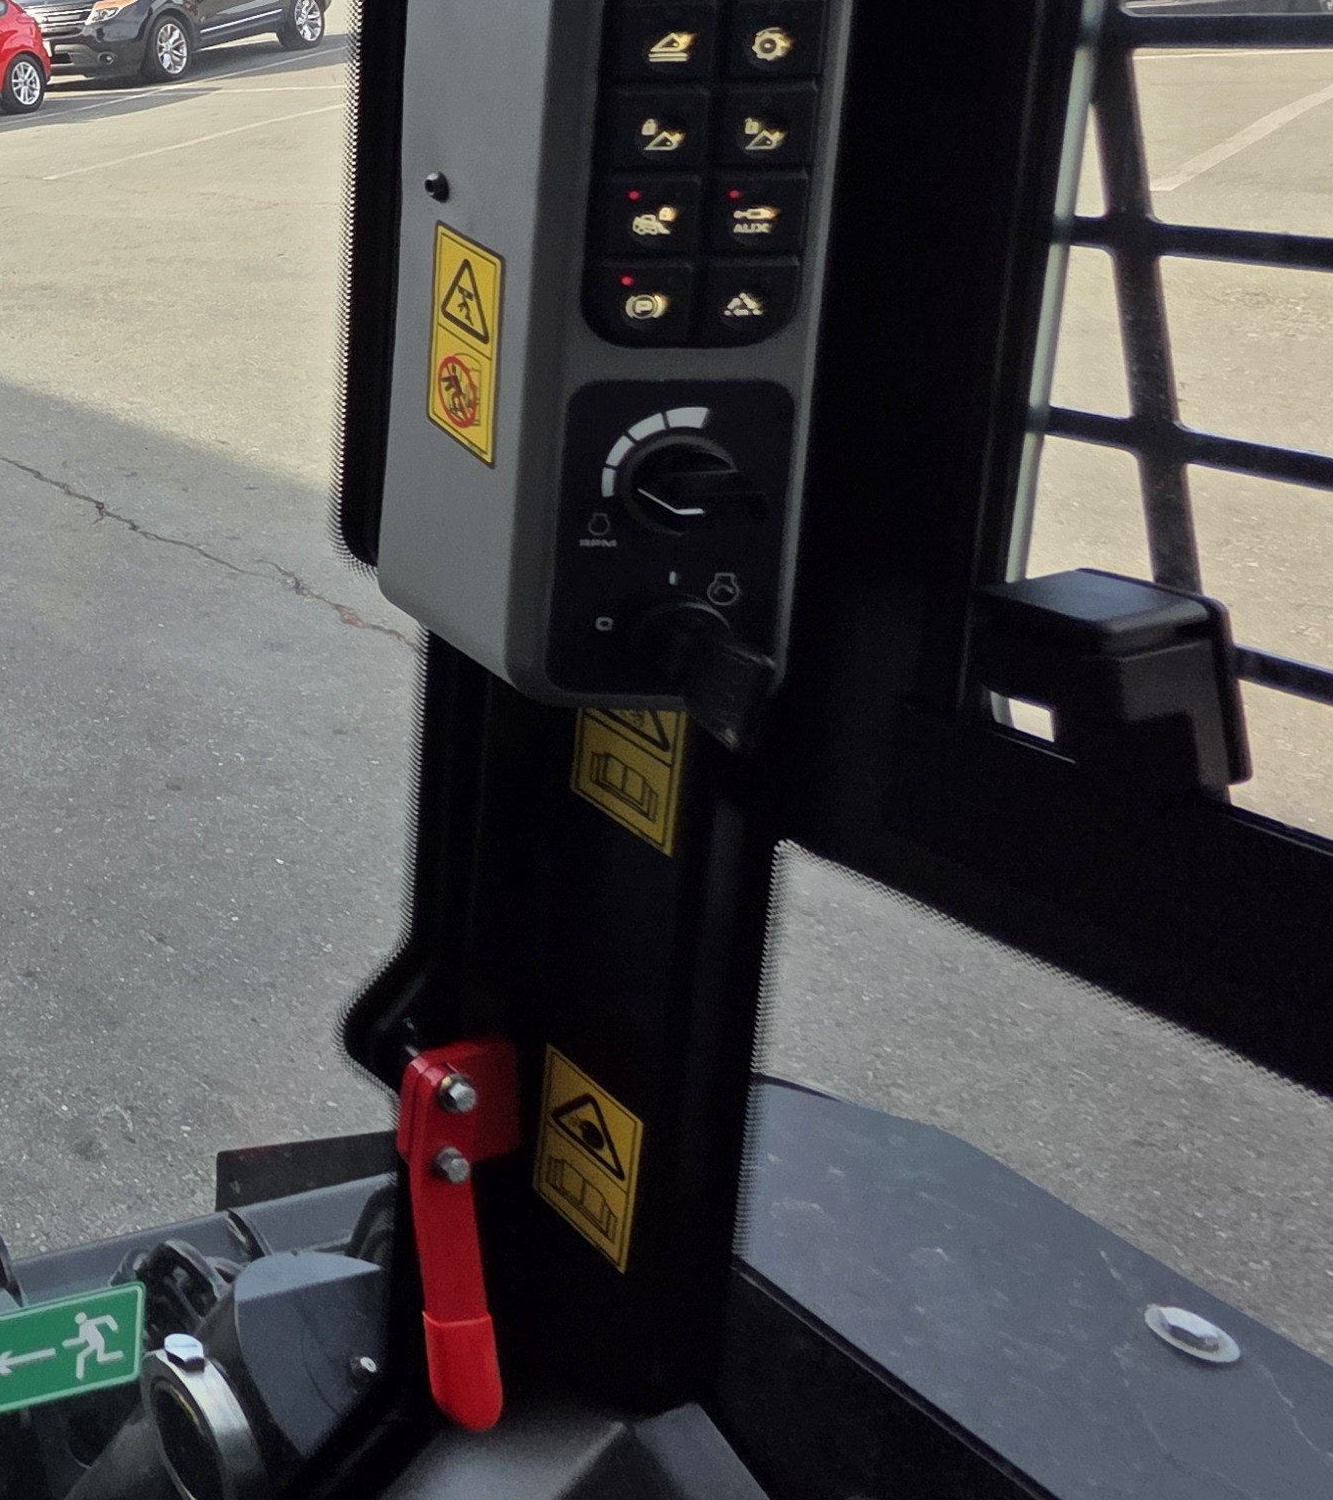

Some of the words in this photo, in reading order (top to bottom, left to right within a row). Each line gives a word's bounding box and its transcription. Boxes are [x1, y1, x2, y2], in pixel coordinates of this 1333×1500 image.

[732, 222, 771, 235] AUX
[635, 300, 653, 314] P
[578, 538, 618, 548] RPM
